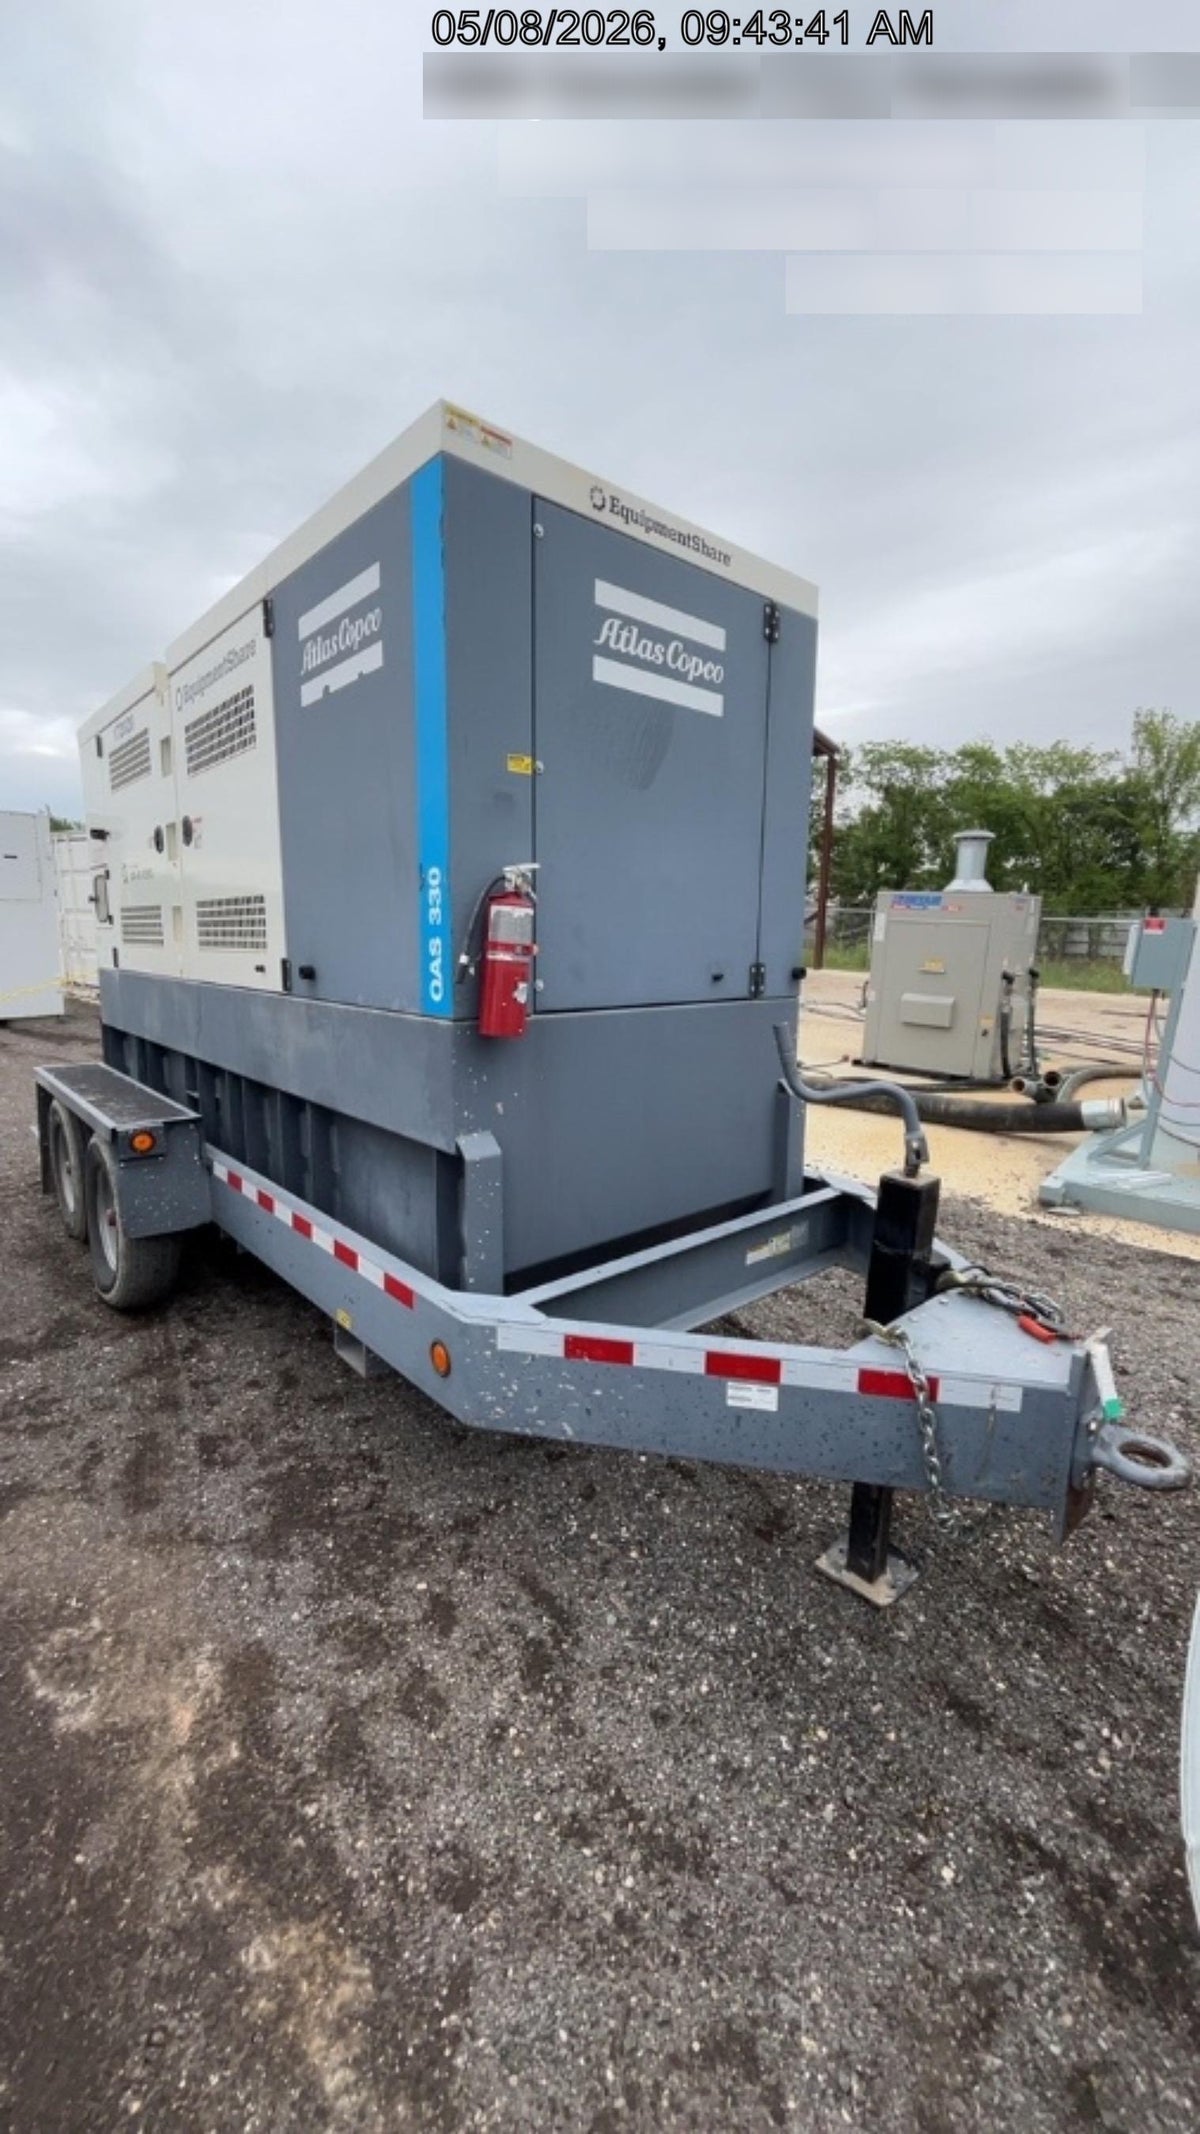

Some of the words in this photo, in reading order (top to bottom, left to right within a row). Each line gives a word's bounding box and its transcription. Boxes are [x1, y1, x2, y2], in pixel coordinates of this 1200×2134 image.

[609, 494, 732, 567] EquipmentShare
[301, 633, 338, 676] Atlas
[338, 607, 382, 651] Copco
[593, 618, 665, 665] Atlas
[666, 639, 725, 684] Copco
[427, 866, 441, 925] 330
